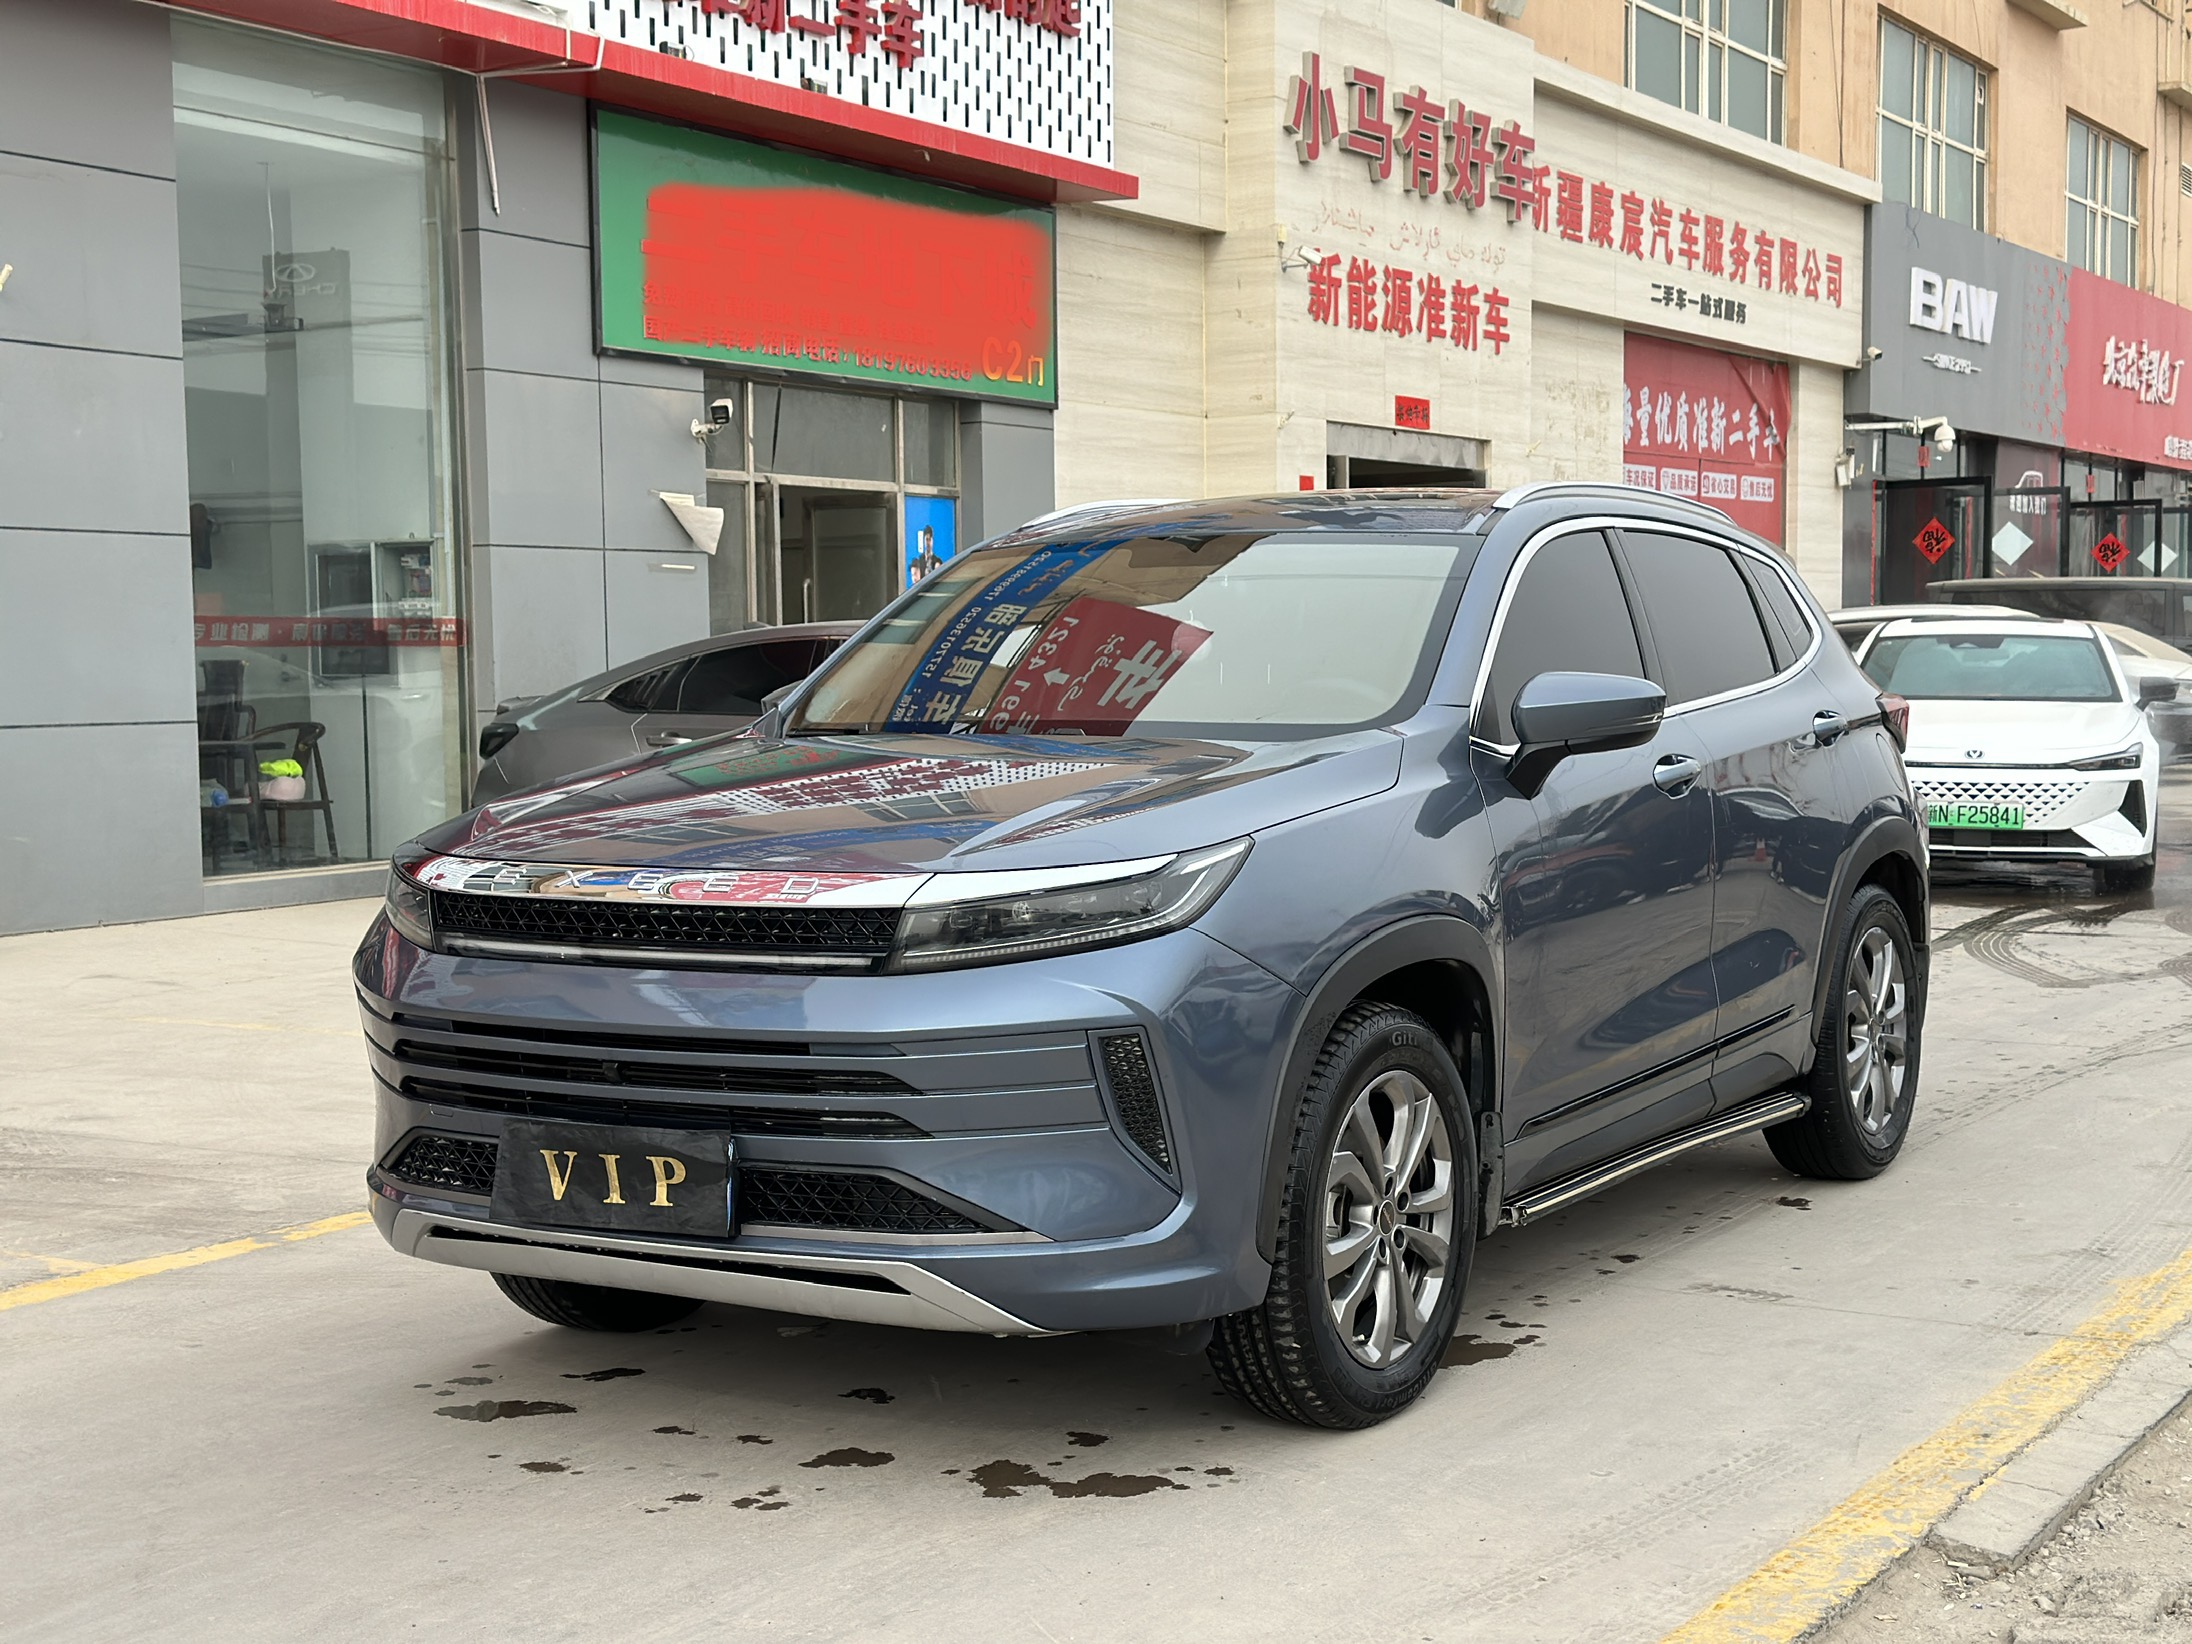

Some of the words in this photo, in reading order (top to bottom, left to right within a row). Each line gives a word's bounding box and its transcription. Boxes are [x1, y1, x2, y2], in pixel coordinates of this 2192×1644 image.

[1283, 51, 1536, 222] 小马有好车
[1307, 248, 1511, 355] 新能源准新车
[1651, 283, 1747, 324] 二手车一站式服务
[1909, 267, 1998, 344] BAW
[493, 865, 820, 895] EXEED
[540, 1149, 687, 1207] VIP
